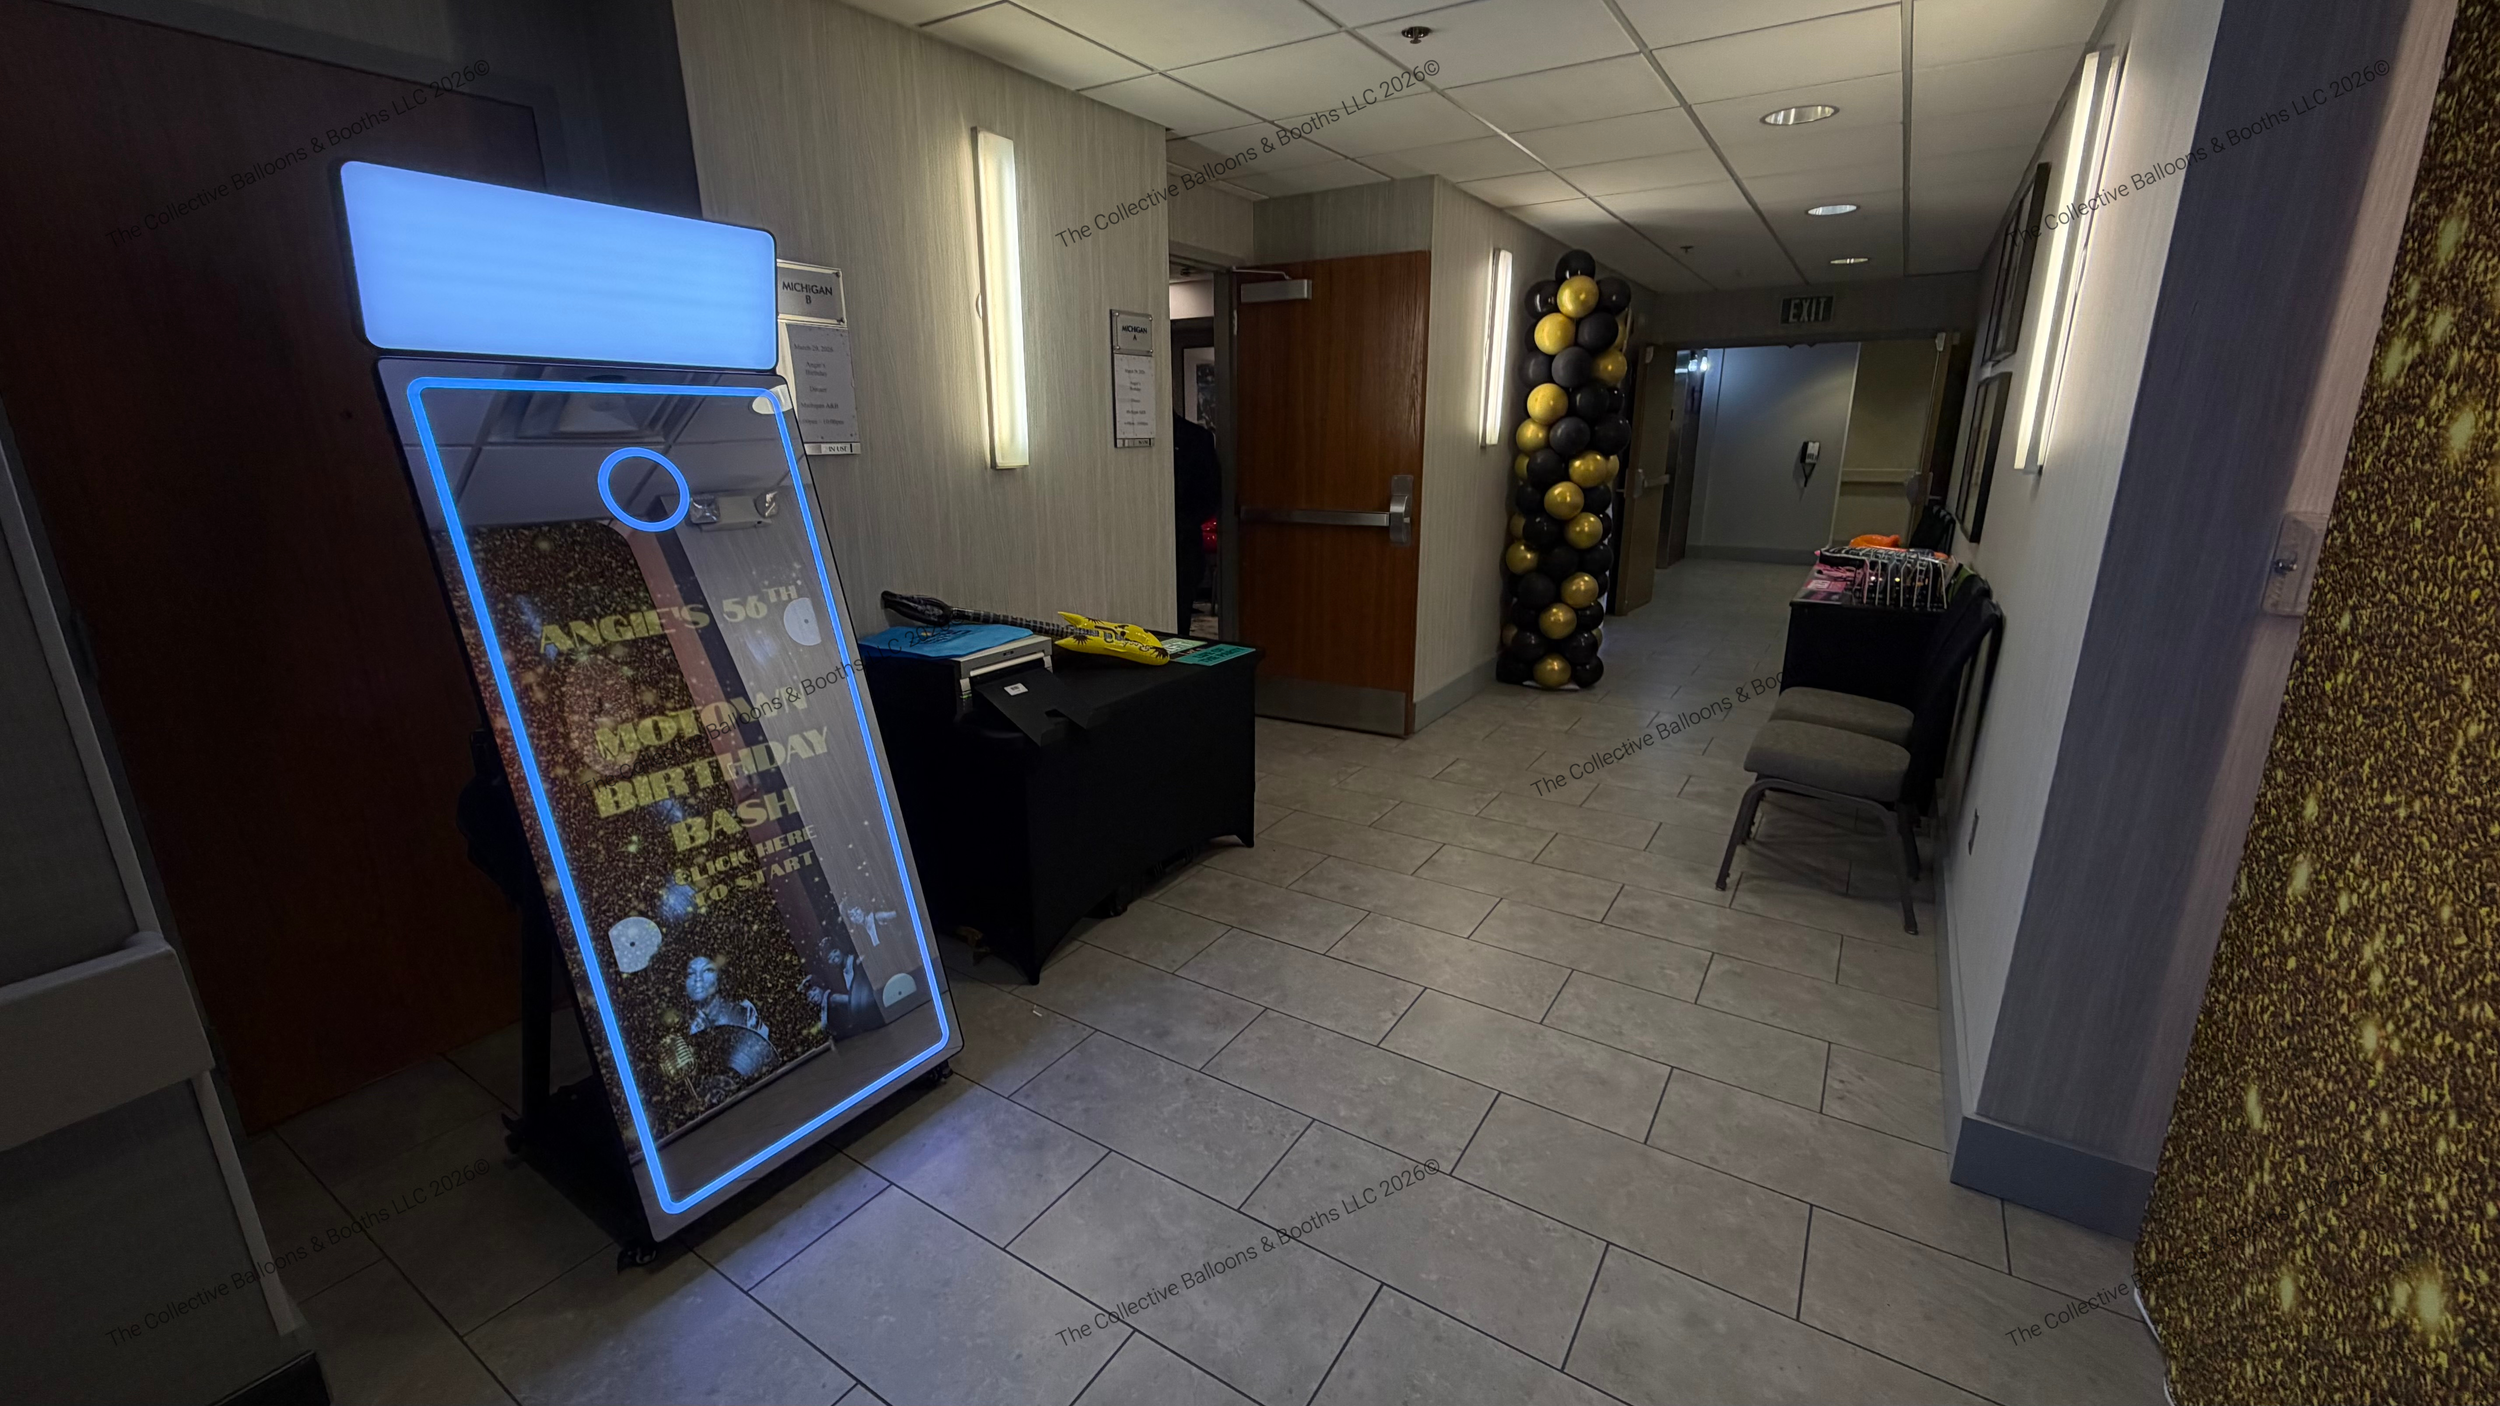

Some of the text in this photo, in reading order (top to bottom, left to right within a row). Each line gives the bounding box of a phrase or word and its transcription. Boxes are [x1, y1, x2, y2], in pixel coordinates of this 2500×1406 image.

[782, 281, 833, 296] MICHIGAN
[805, 294, 812, 305] B
[1121, 325, 1148, 334] MICHIGAN
[1788, 298, 1827, 323] EXIT
[540, 603, 710, 652] ANGIE'S
[594, 683, 809, 761] MOTOWN
[590, 725, 830, 819] BIRTHDAY
[670, 787, 800, 852] BASH
[756, 824, 818, 857] HERE
[693, 849, 816, 908] TO START
